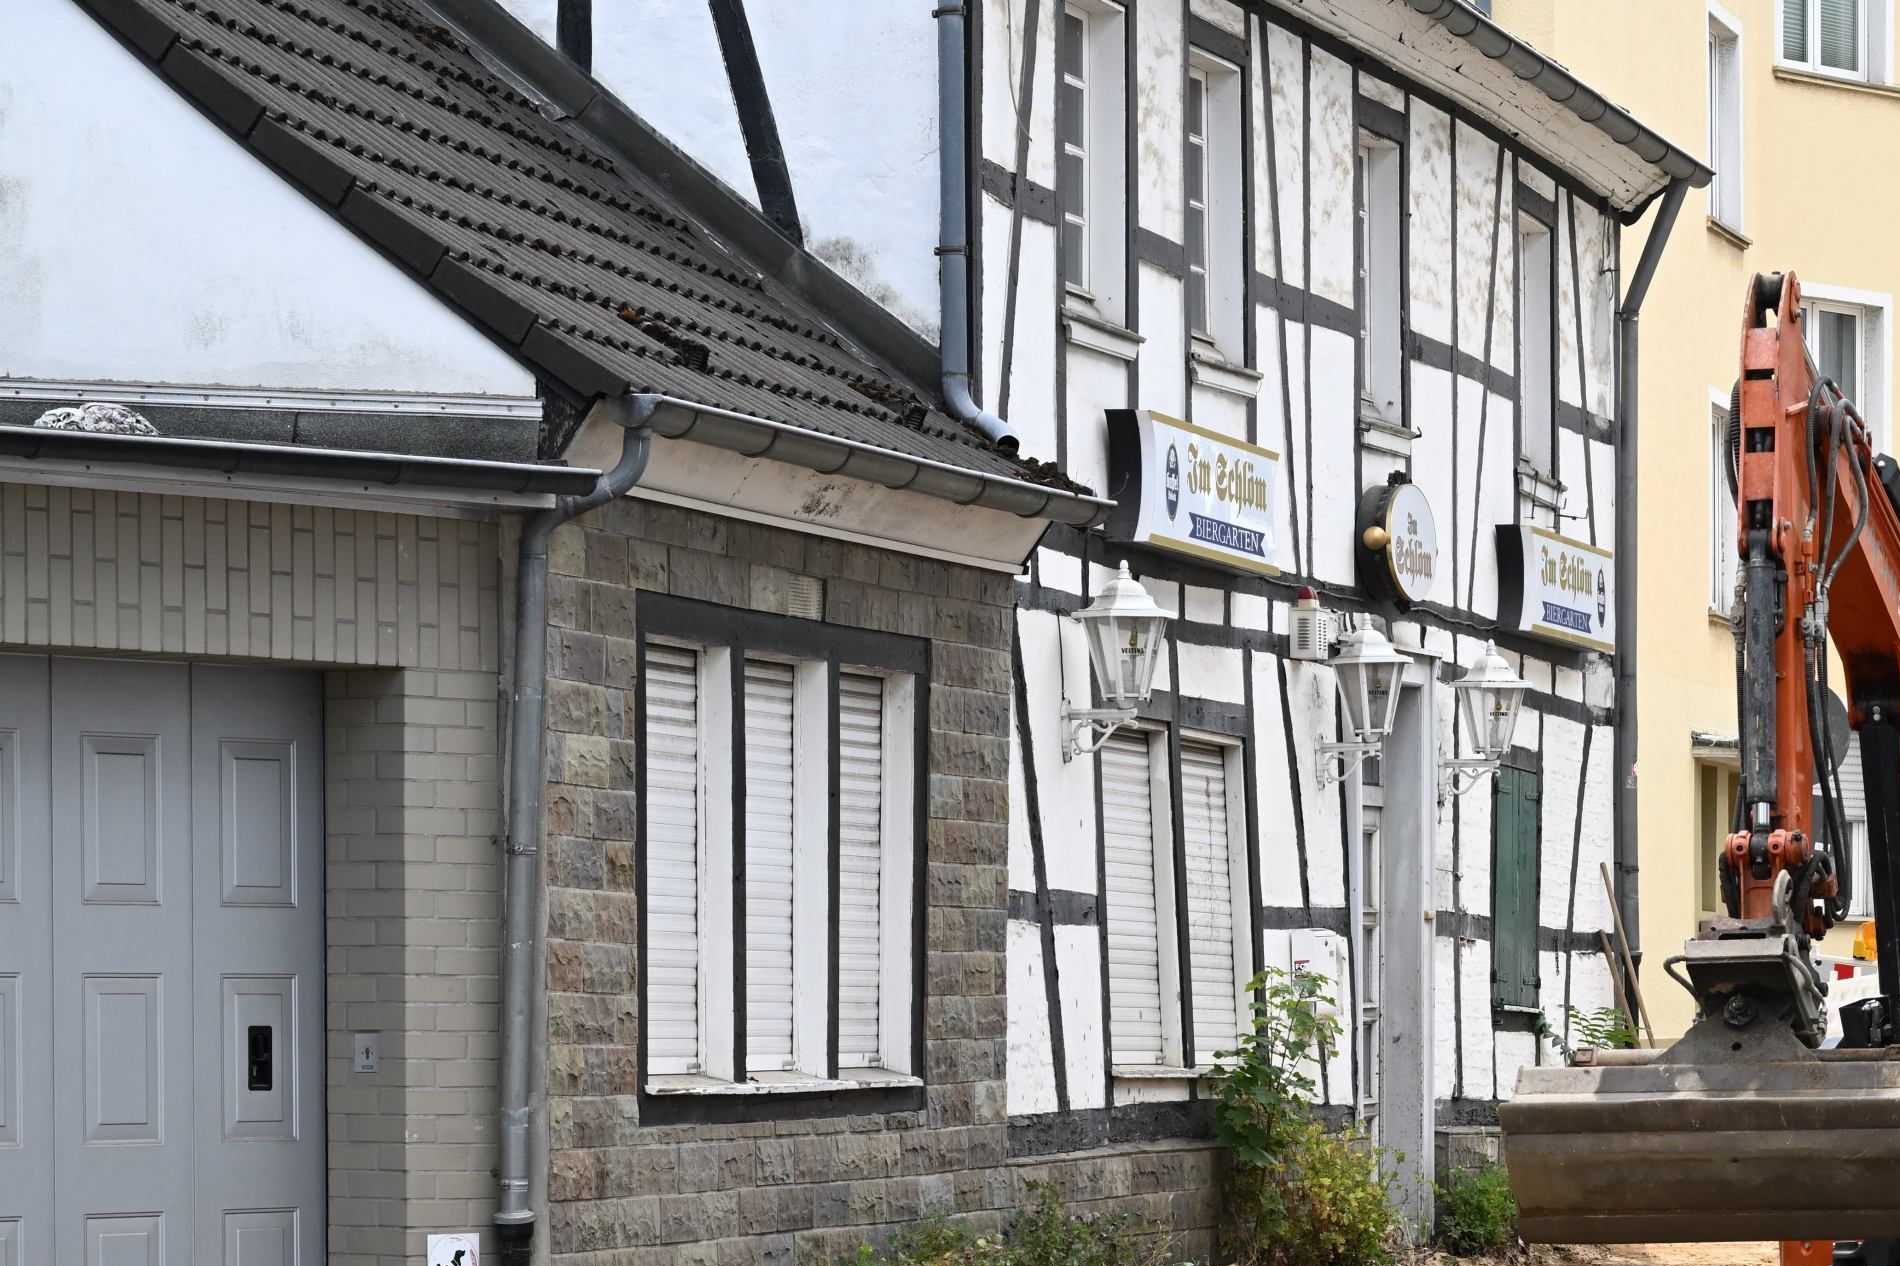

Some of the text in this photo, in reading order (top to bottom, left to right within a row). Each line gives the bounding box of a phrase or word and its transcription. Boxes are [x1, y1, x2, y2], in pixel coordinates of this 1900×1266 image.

[1187, 442, 1268, 518] Im Schlöm
[1195, 516, 1260, 553] BIERGARTEN
[1395, 535, 1433, 588] Schlöm
[1540, 544, 1593, 605] Im Schlöm
[1545, 604, 1589, 631] BIERGARTEN
